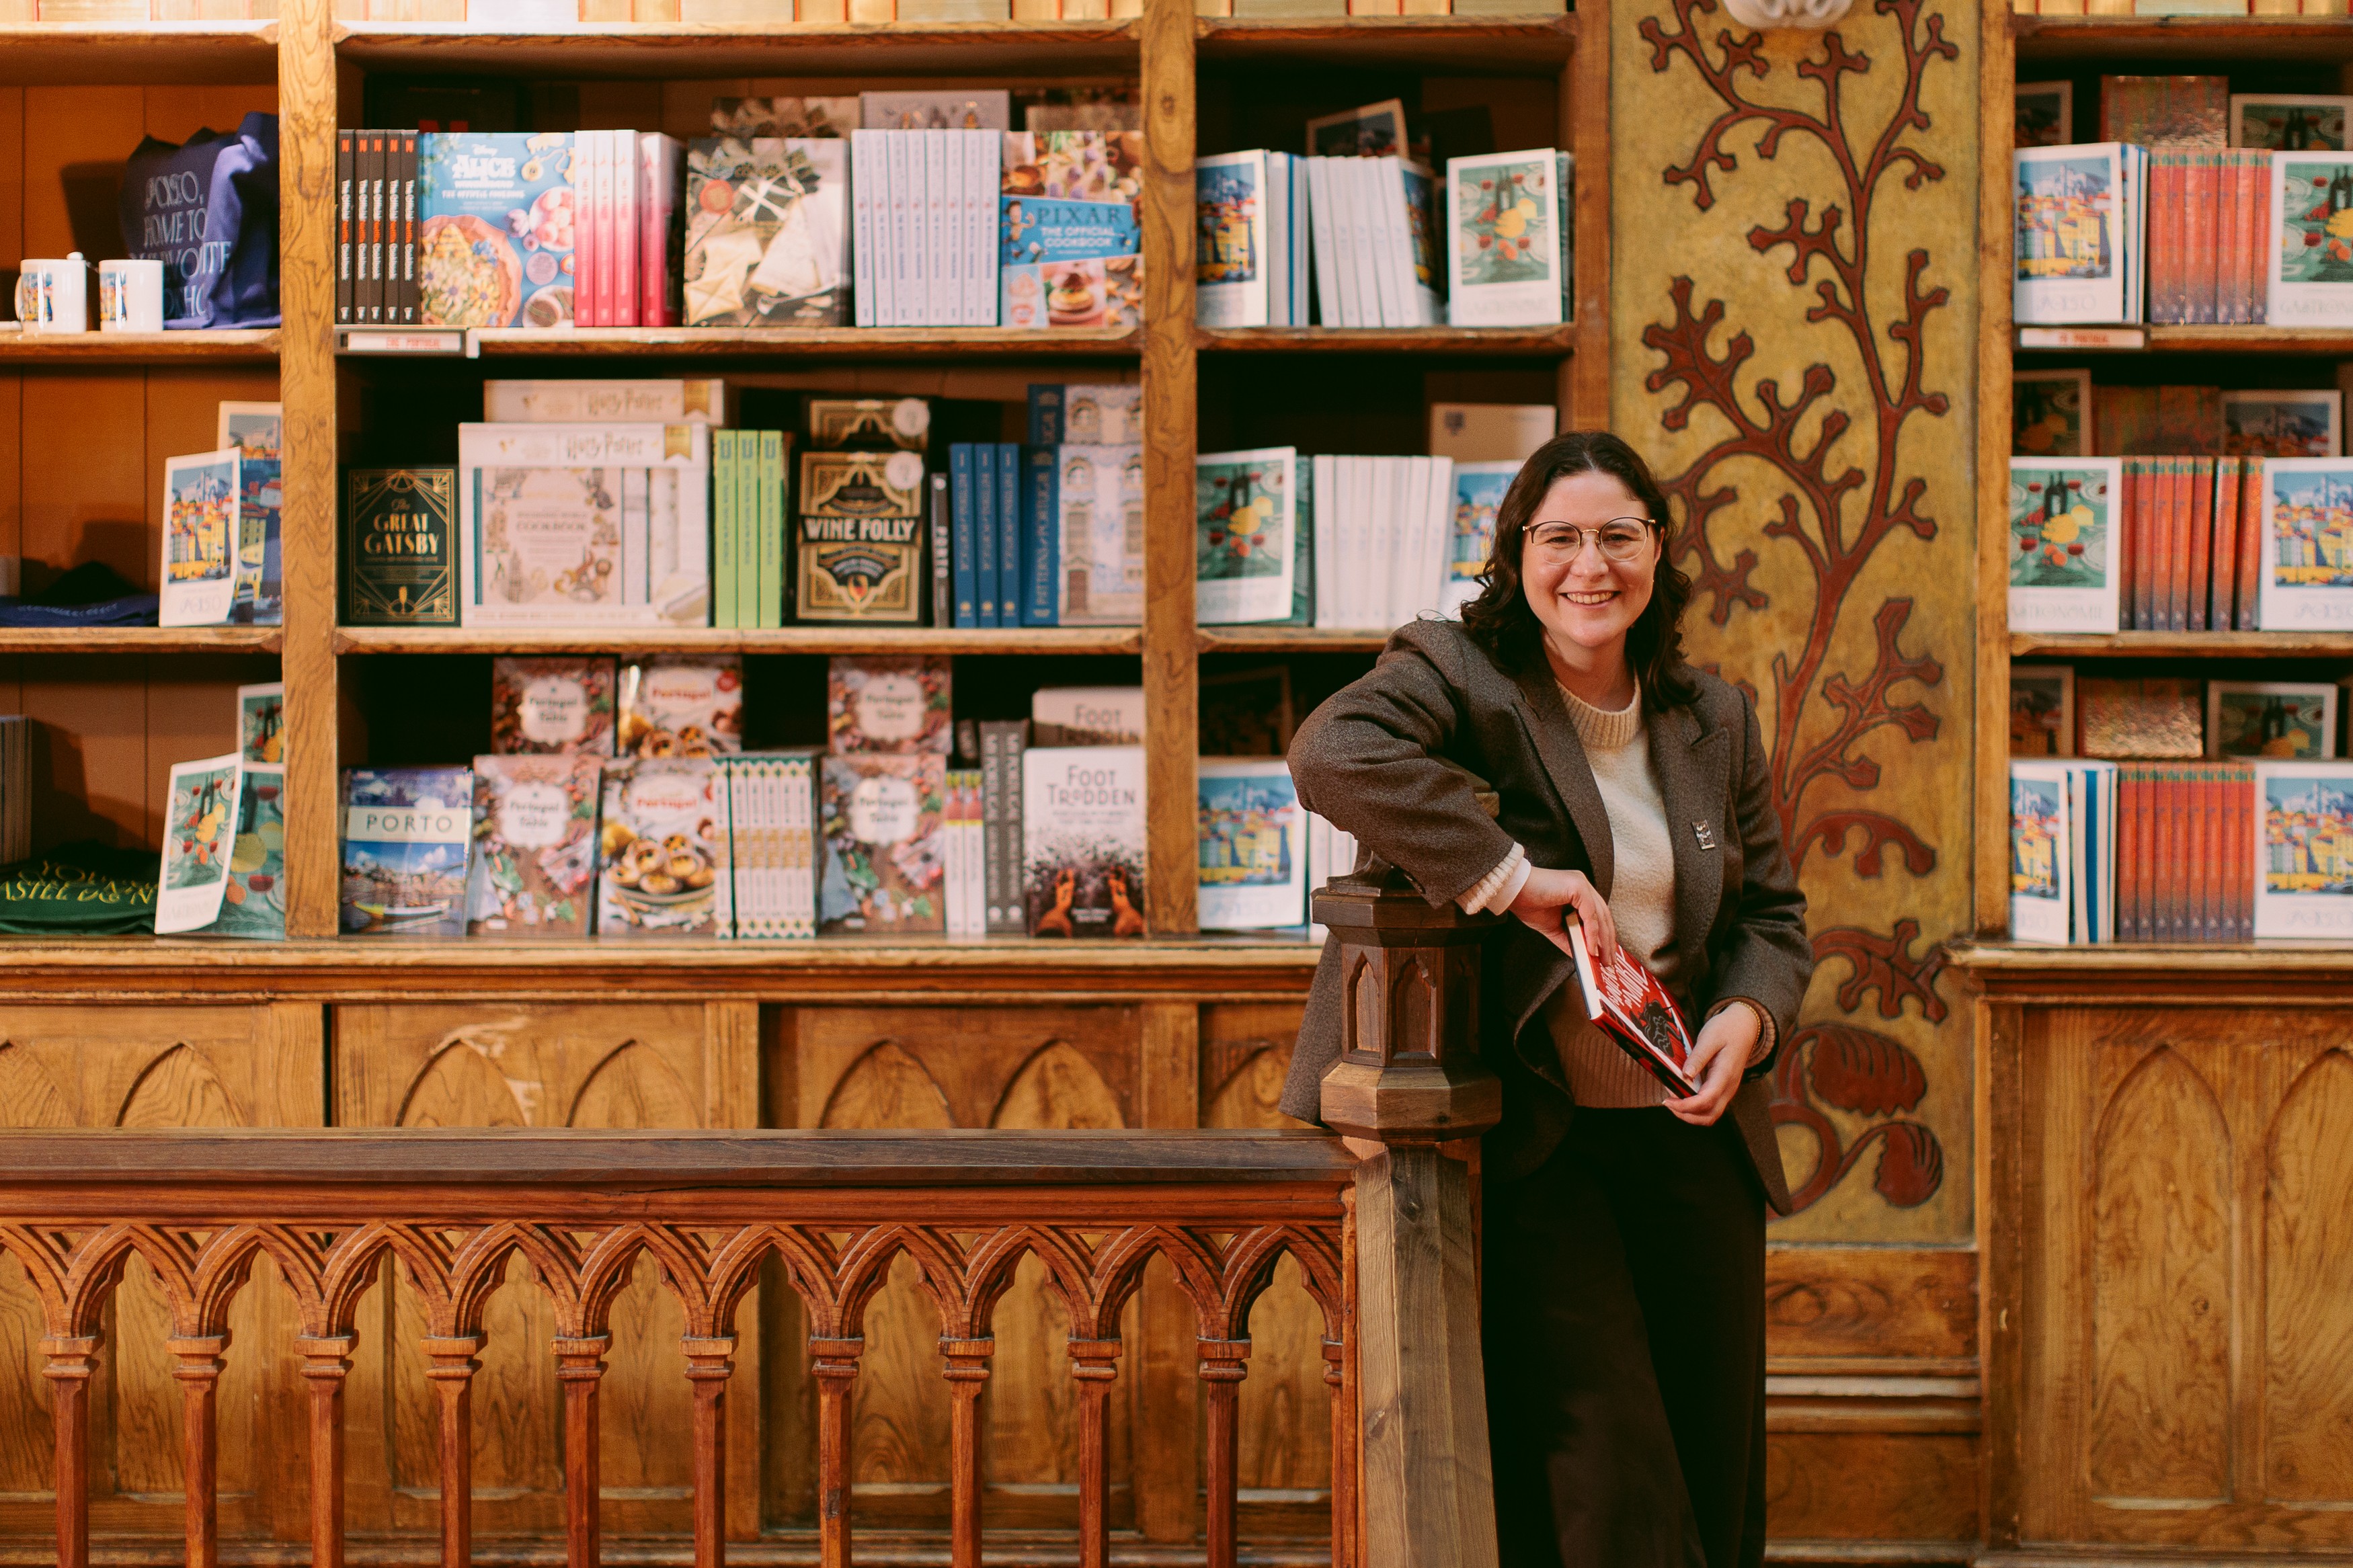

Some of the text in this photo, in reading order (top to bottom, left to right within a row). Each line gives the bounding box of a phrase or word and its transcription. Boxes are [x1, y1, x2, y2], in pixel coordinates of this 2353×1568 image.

[1038, 207, 1121, 224] PIXAR
[1041, 226, 1115, 237] THE OFFICIAL
[1044, 237, 1113, 247] COOKBOOK
[340, 243, 350, 281] Cookbook
[358, 243, 367, 281] Cookbook
[372, 243, 382, 281] Cookbook
[389, 243, 398, 281] Cookbook
[404, 243, 414, 281] Cookbook
[374, 513, 429, 532] GREAT
[805, 518, 916, 541] WINE FOLLY
[364, 533, 439, 554] GATSBY
[1068, 765, 1116, 786] FOOT
[1047, 784, 1135, 807] TRODDEN
[366, 814, 452, 833] PORTO
